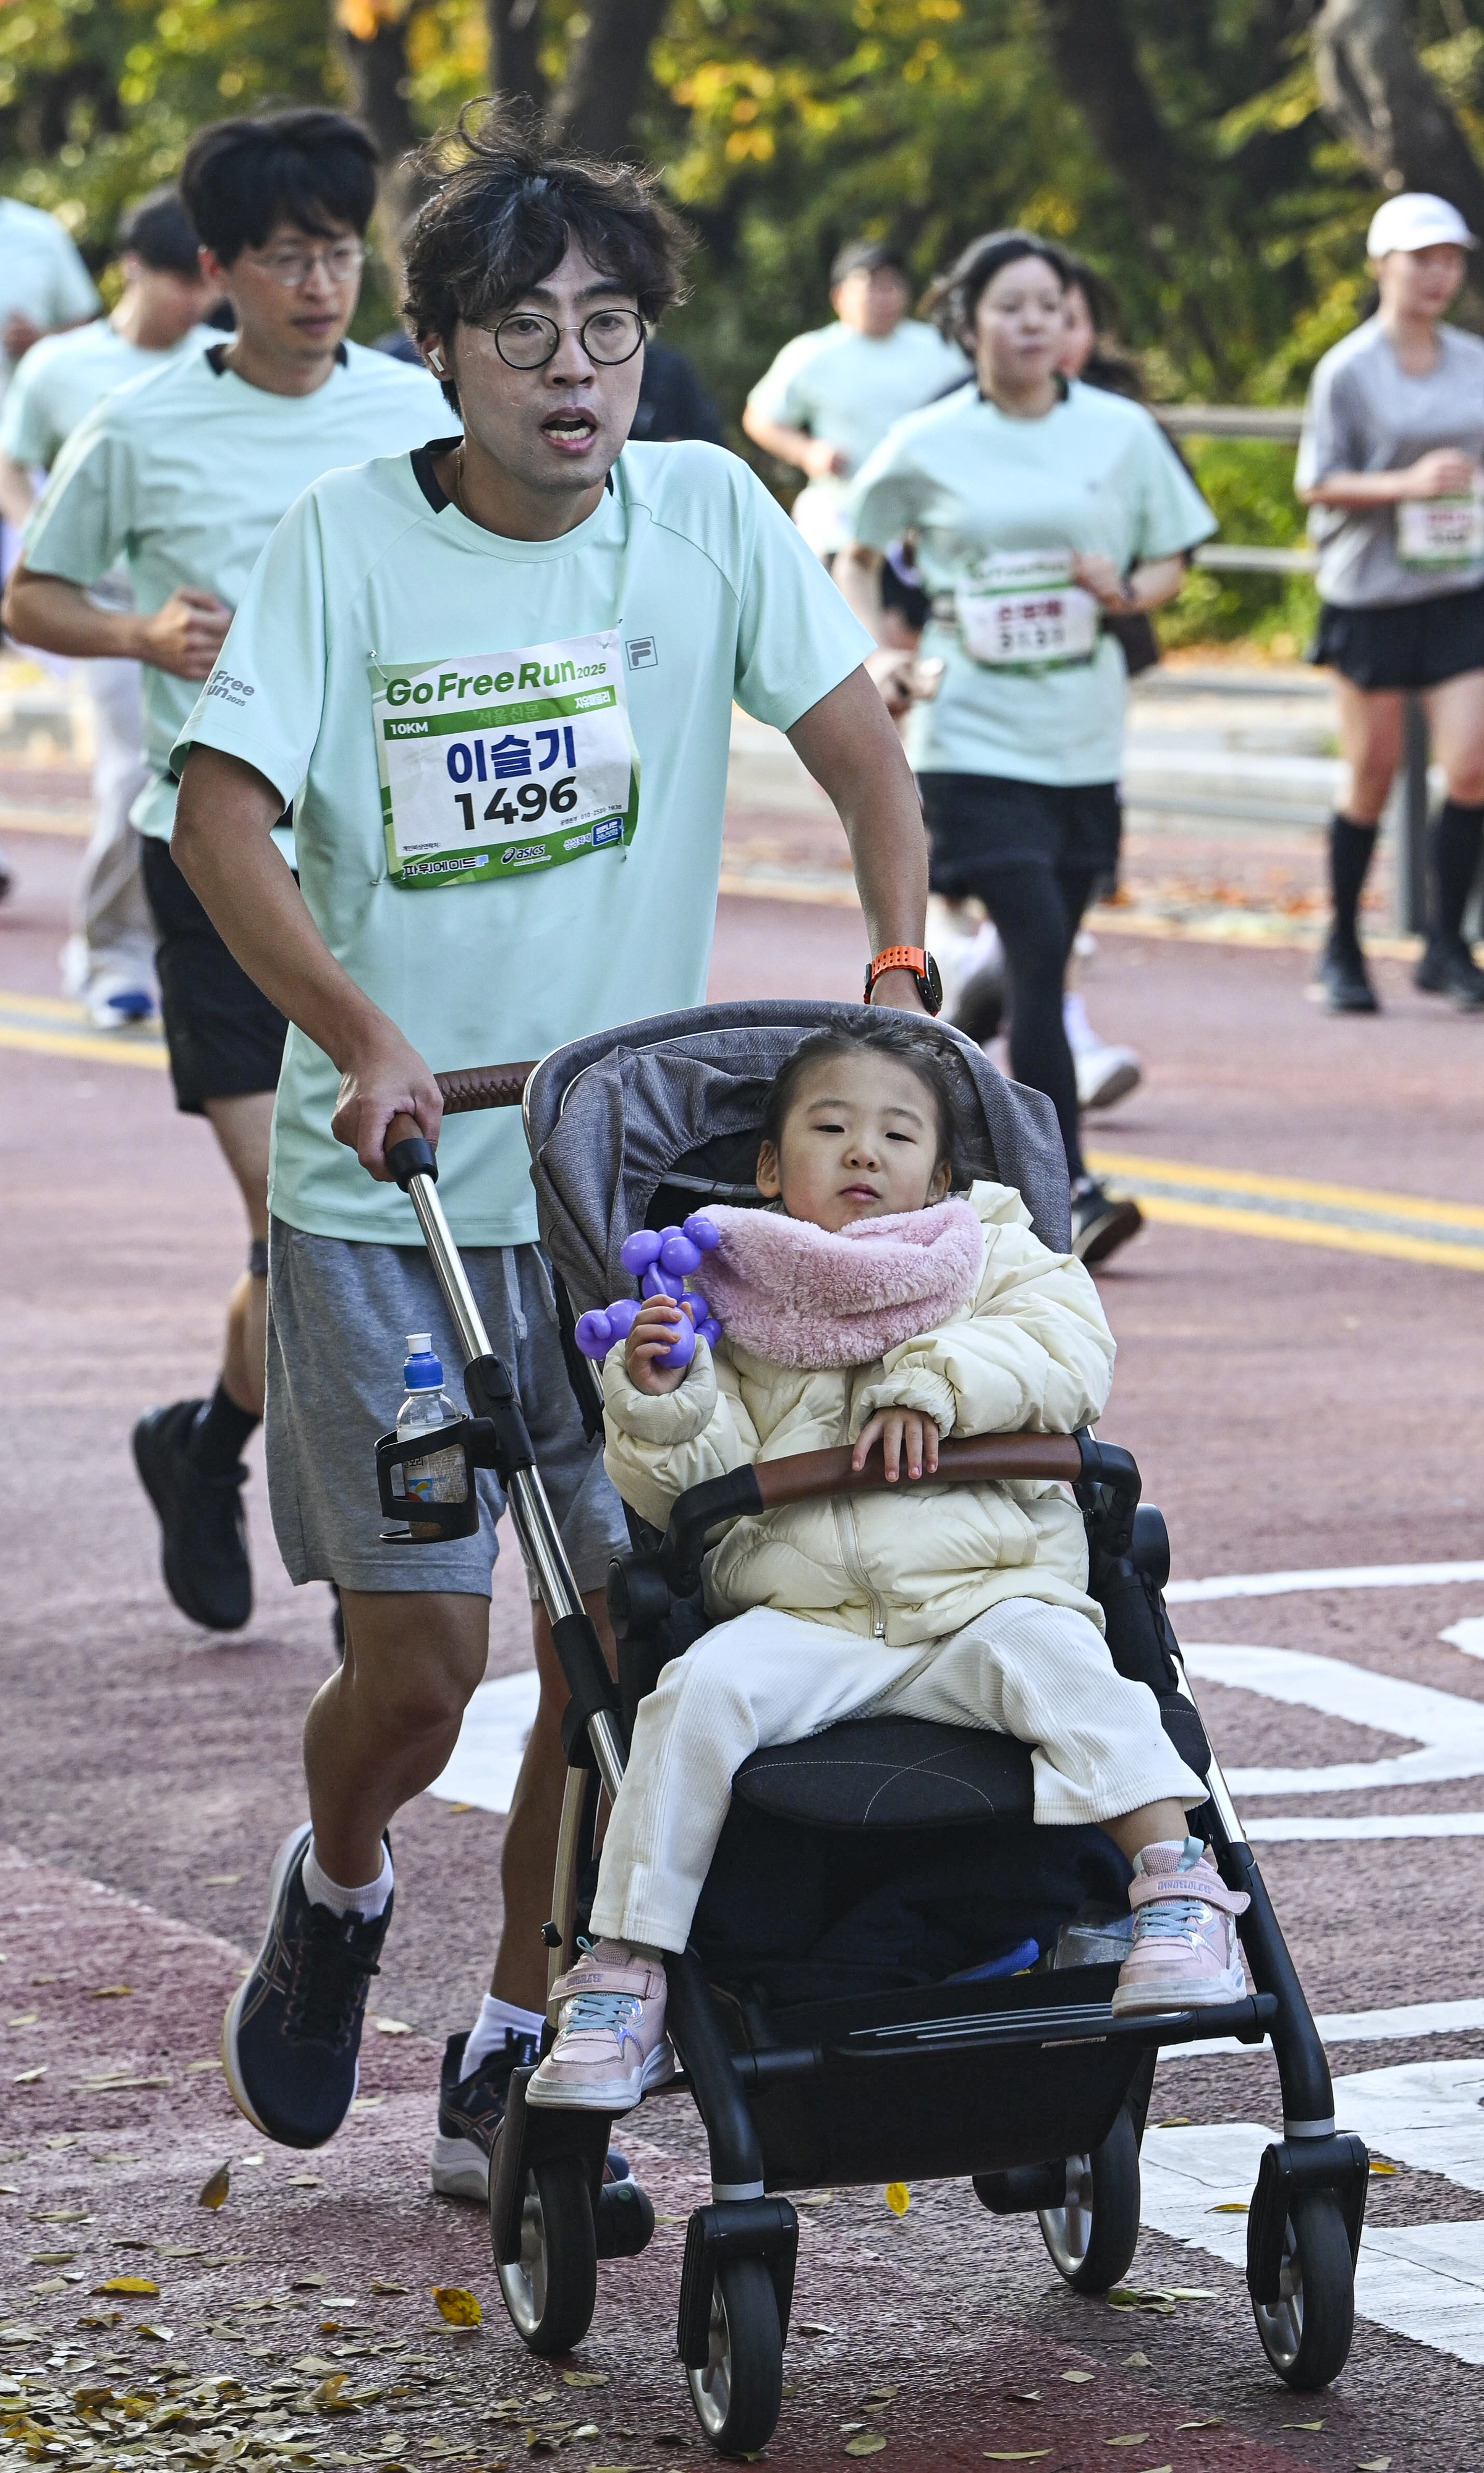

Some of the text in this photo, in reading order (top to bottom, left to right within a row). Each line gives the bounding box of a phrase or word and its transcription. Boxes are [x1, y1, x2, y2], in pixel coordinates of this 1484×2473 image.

[389, 721, 428, 735] 10KM
[446, 726, 577, 783] 이슬기
[454, 776, 578, 830] 1496
[403, 857, 477, 875] 파워에이드
